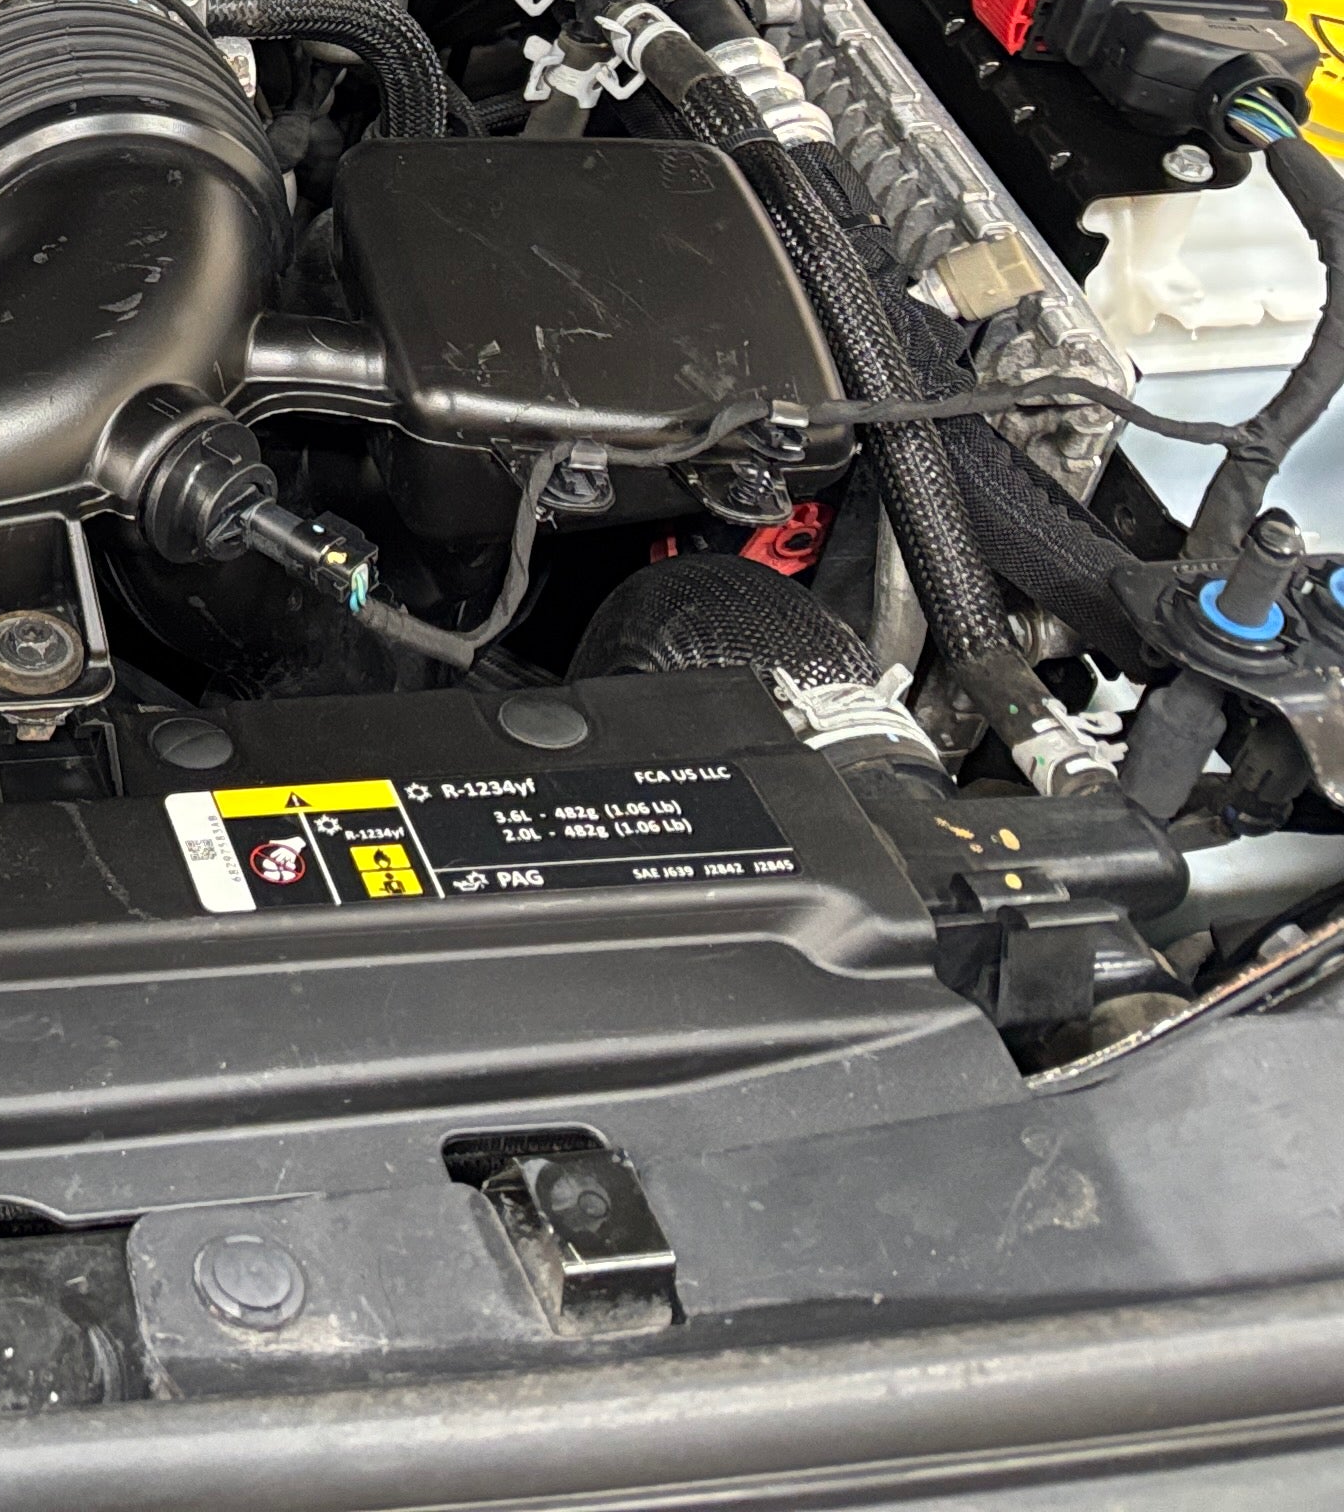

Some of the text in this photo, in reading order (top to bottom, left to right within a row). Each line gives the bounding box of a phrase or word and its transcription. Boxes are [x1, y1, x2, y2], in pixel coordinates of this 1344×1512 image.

[634, 766, 732, 785] FCA US LLC
[440, 778, 537, 799] R-1234yf
[493, 810, 533, 825] 3.6L
[554, 805, 600, 821] 482g
[604, 802, 650, 820] (1.06
[652, 800, 682, 816] Lb)
[344, 826, 404, 840] R-1234yf
[502, 827, 542, 843] 2.0L
[564, 823, 610, 839] 482g
[614, 821, 661, 838] (1.06
[663, 818, 693, 835] Lb)
[497, 869, 544, 887] PAG
[632, 860, 794, 881] SAE J639 J2842 J2845
